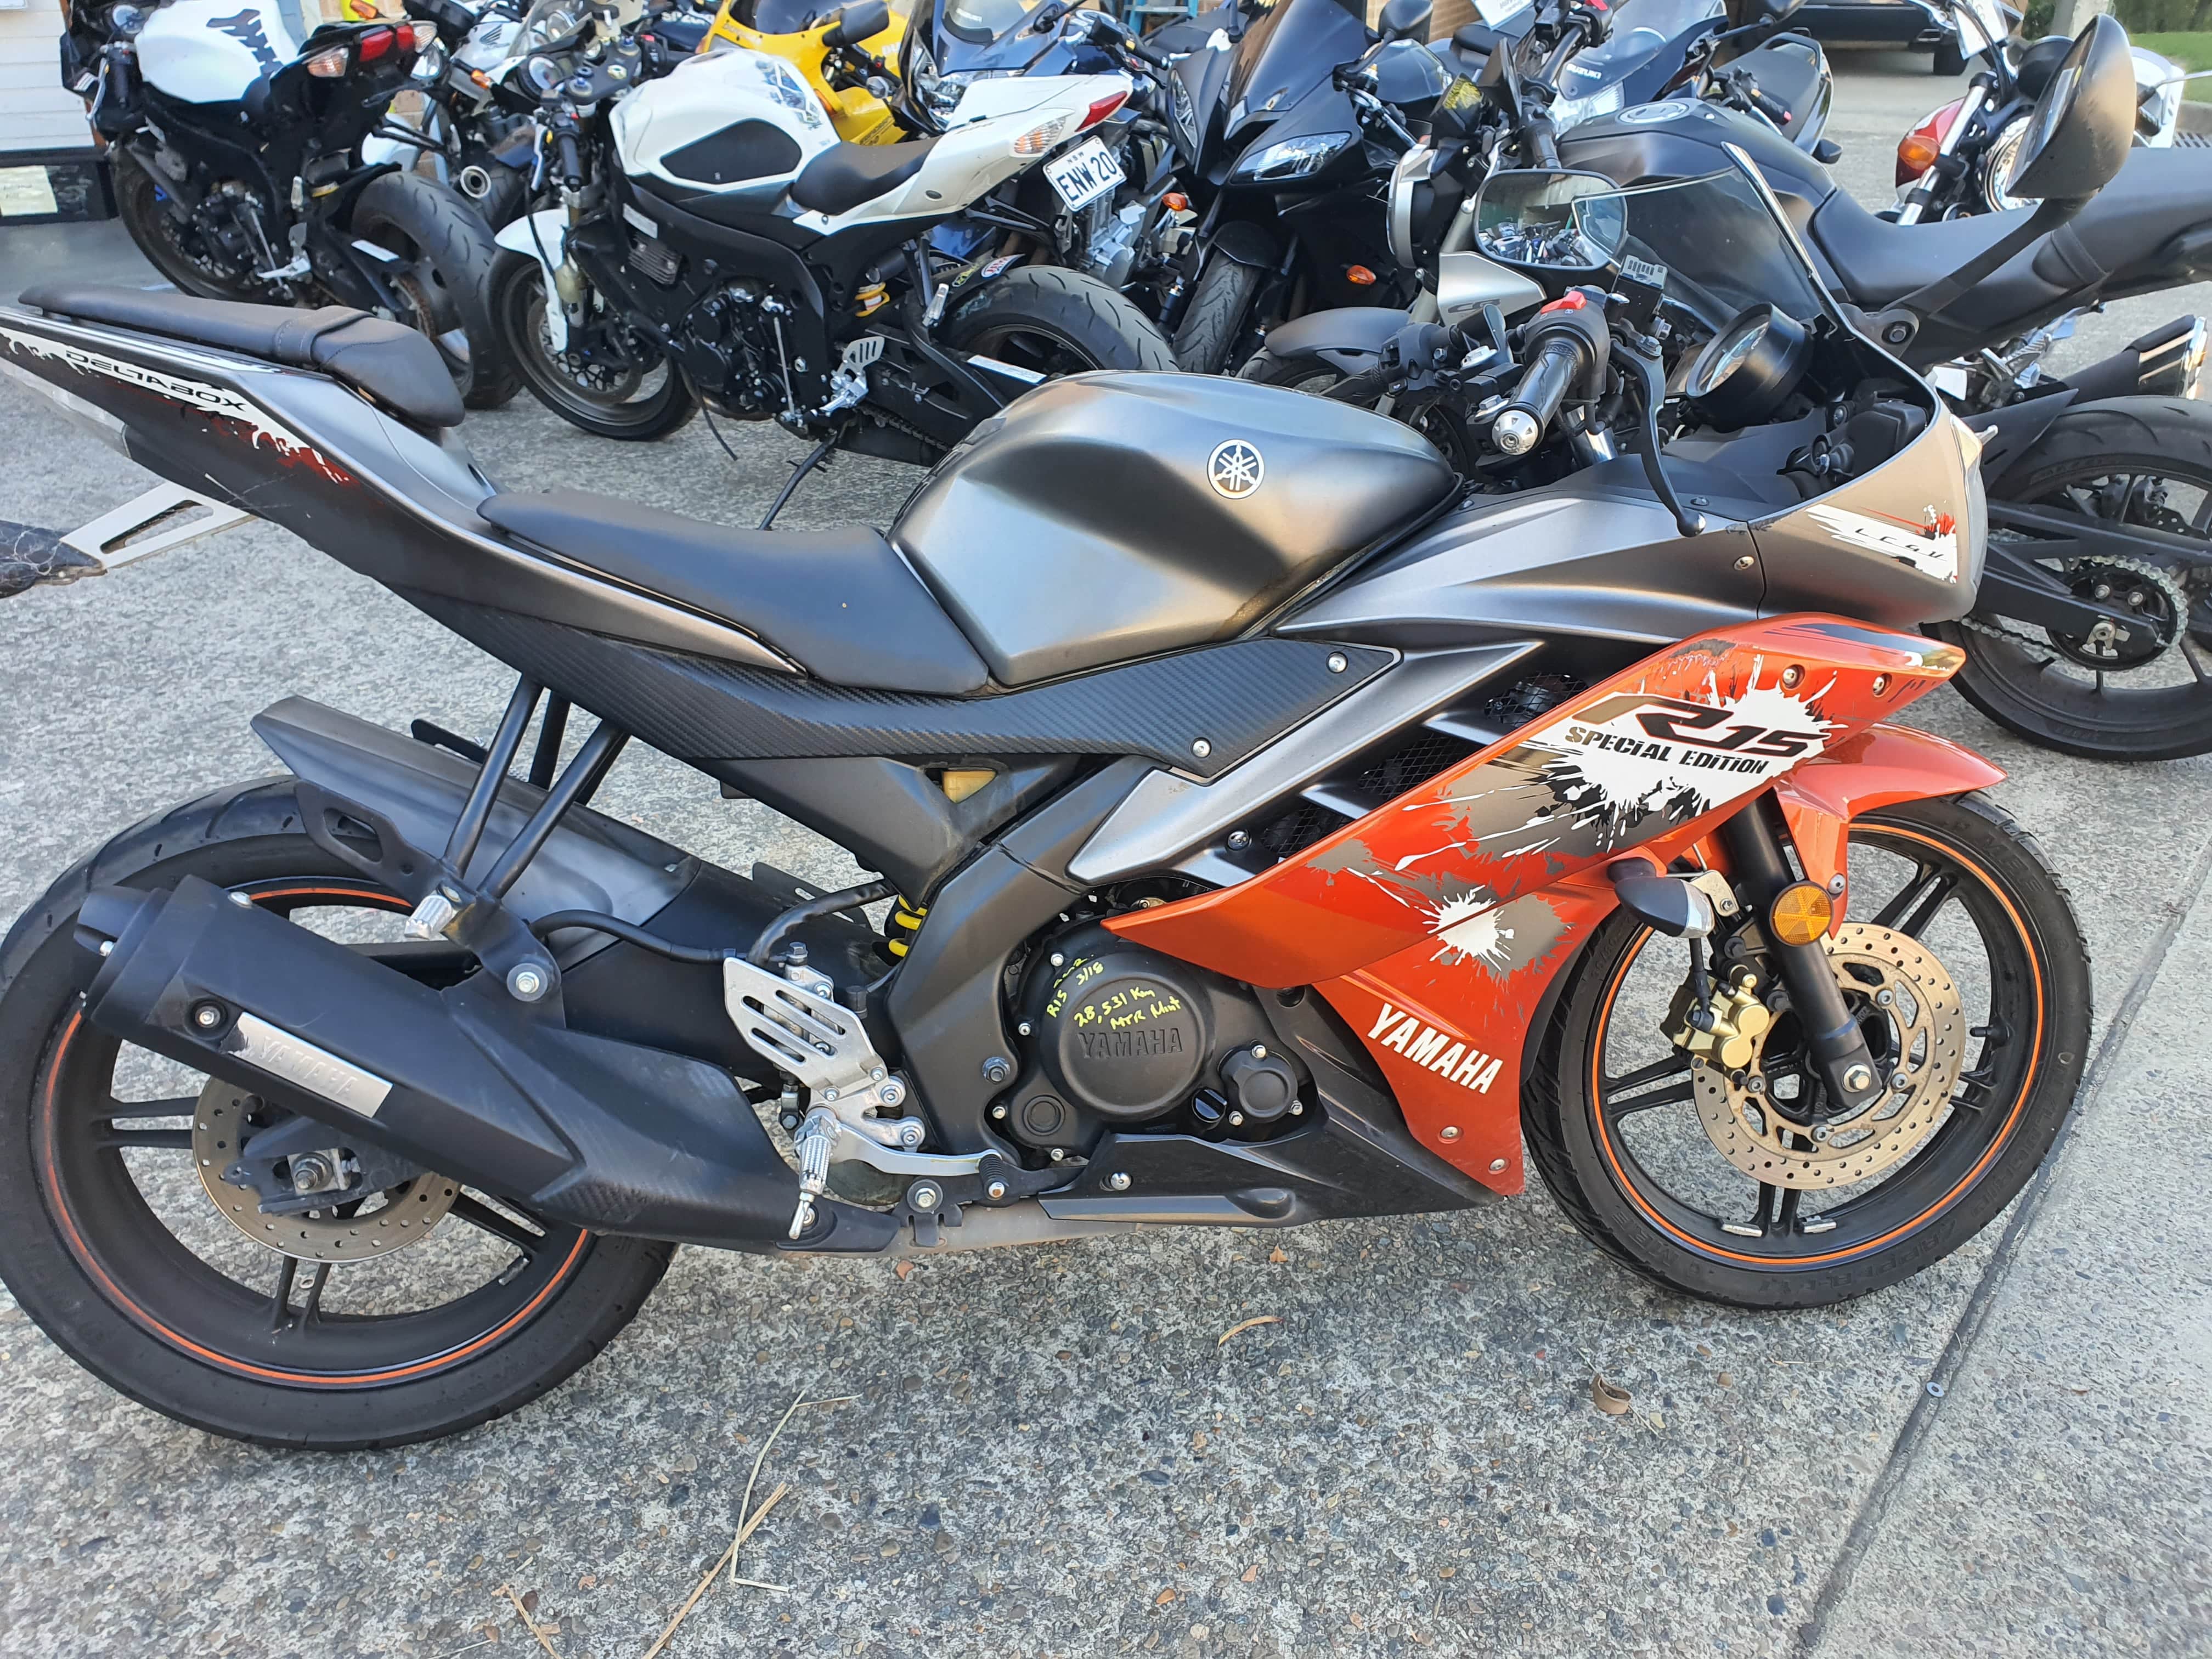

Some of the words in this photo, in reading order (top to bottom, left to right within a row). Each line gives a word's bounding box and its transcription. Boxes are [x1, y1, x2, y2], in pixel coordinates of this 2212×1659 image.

[1057, 162, 1097, 201] ENW
[1091, 151, 1117, 181] 20
[1066, 151, 1084, 163] NSW
[65, 350, 246, 412] DELTABOX
[1572, 695, 1831, 758] R15
[1046, 989, 1068, 1018] R15
[1074, 992, 1127, 1027] 28,531
[259, 1035, 359, 1101] YAMAHA
[1077, 1027, 1183, 1059] YAMAHA
[1367, 1003, 1504, 1094] YAMAHA
